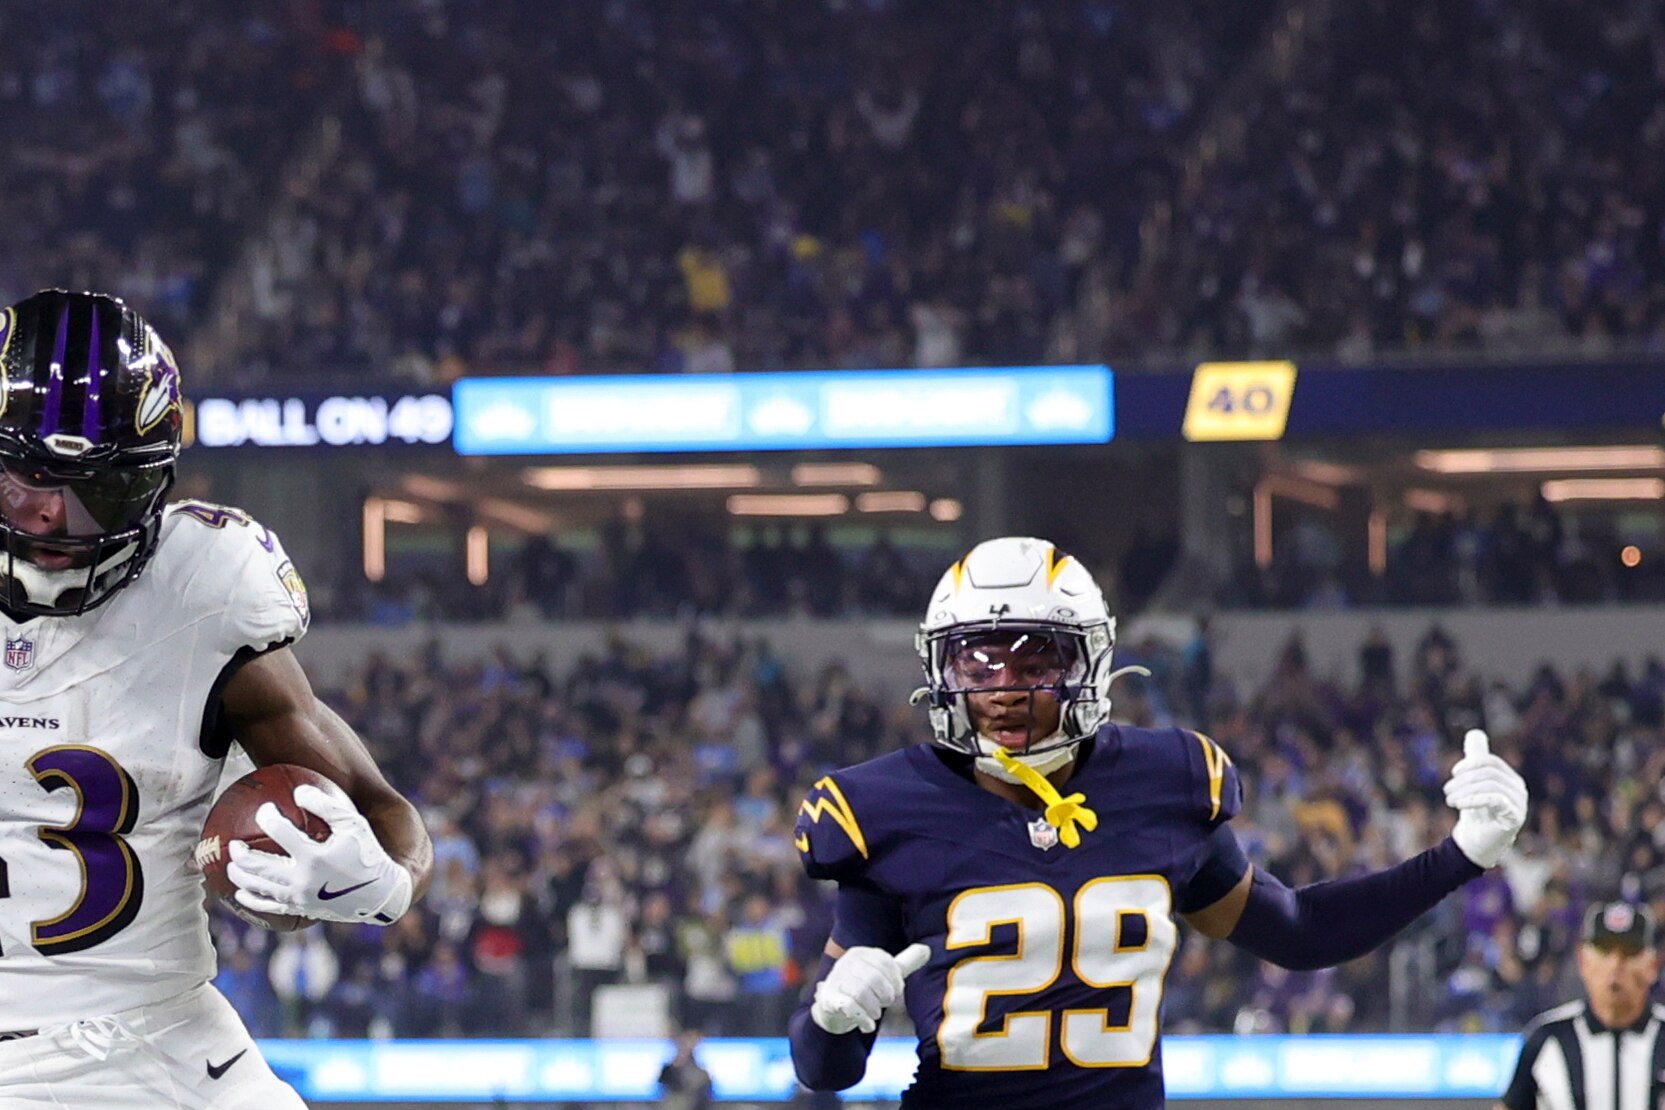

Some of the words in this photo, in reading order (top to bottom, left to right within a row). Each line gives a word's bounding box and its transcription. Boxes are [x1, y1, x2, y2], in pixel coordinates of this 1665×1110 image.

[198, 398, 320, 447] BALL
[316, 396, 388, 445] ON
[1208, 387, 1274, 417] 40
[989, 603, 1011, 619] LA
[937, 874, 1177, 1072] 29
